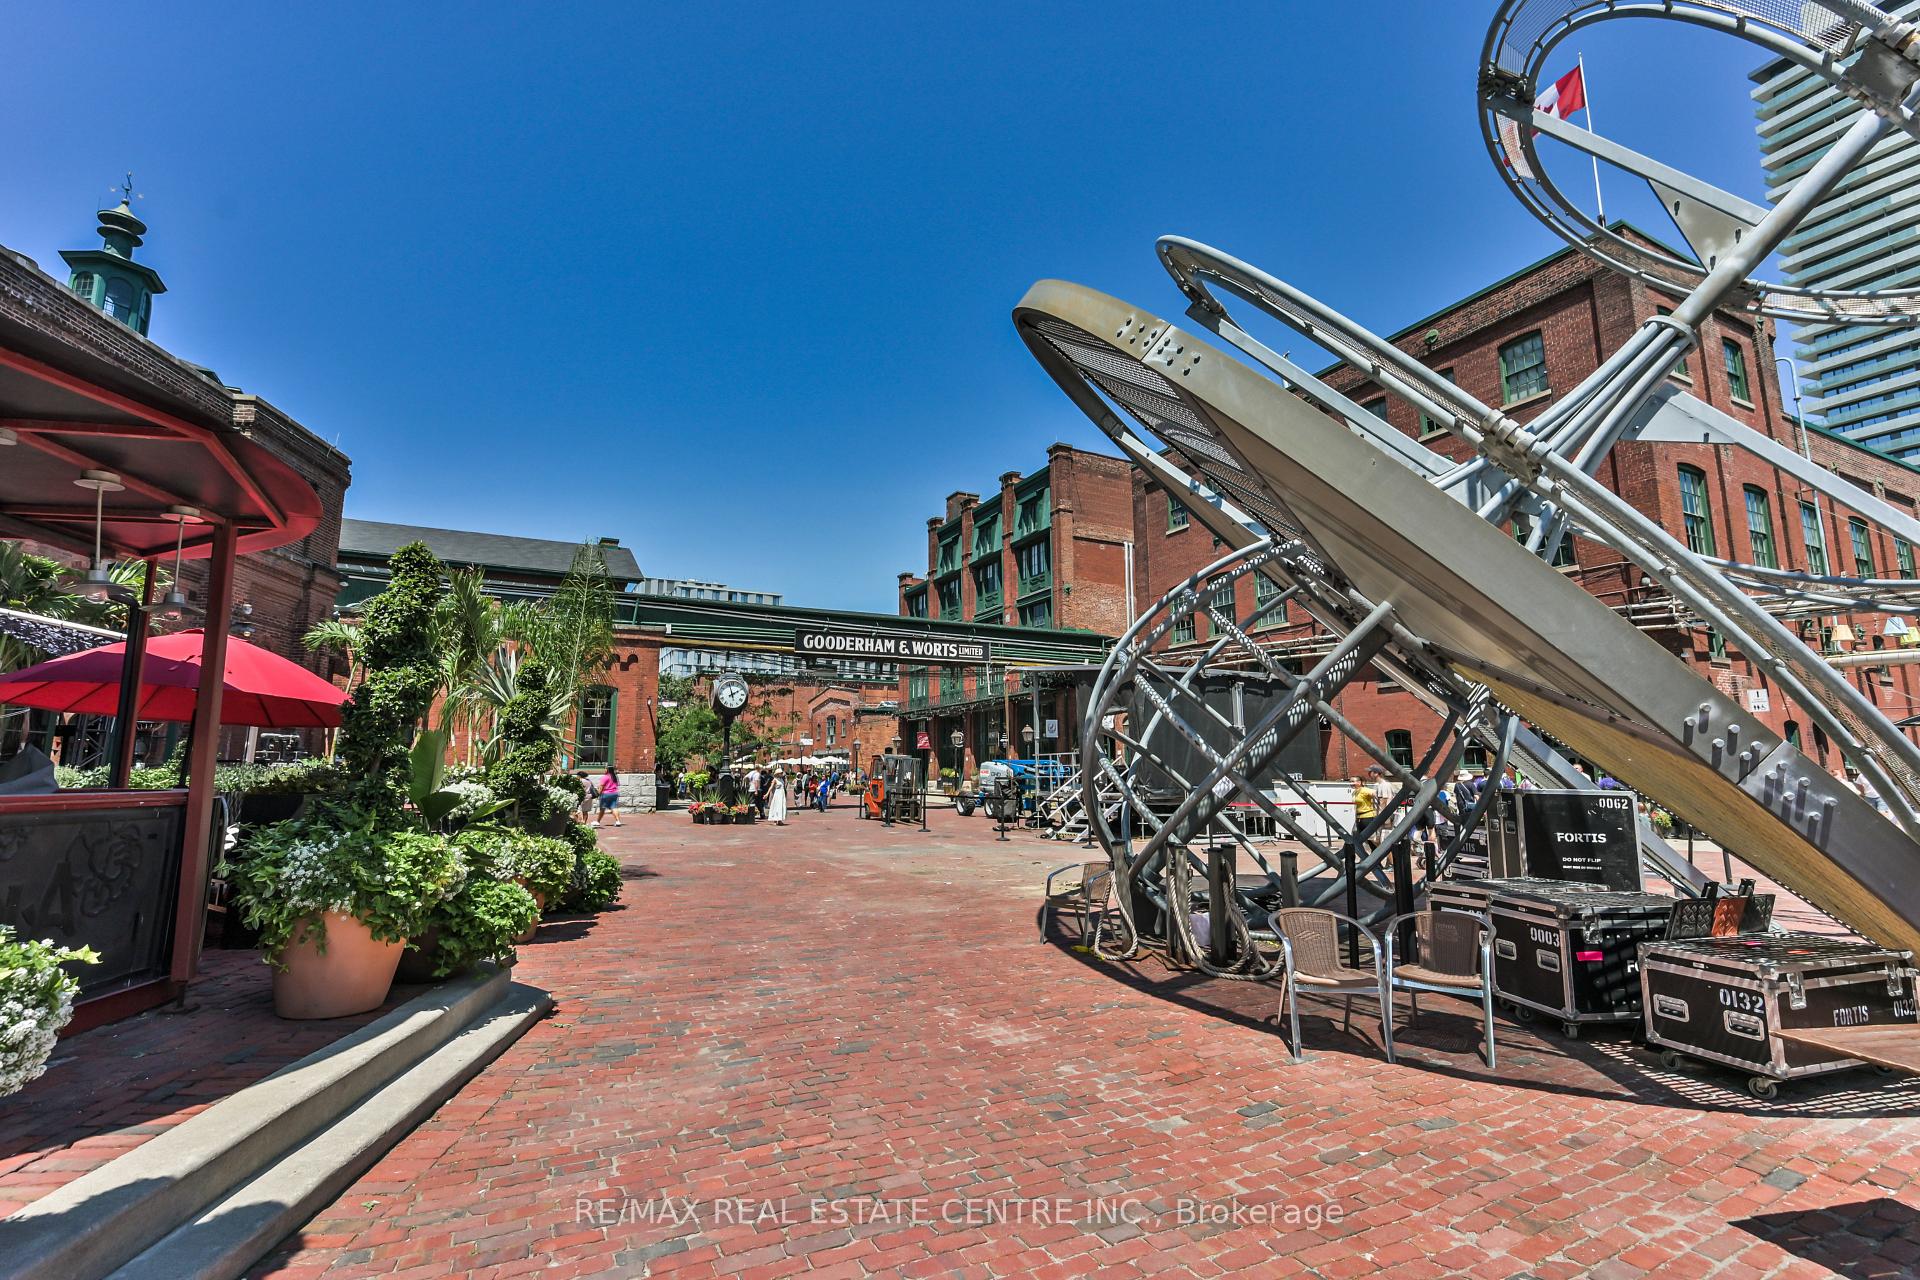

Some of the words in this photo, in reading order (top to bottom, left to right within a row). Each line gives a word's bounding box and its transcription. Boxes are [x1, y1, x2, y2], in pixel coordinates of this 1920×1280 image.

[803, 634, 895, 654] GOODERHAM
[899, 640, 910, 655] &
[911, 642, 958, 657] WORTS
[958, 646, 983, 656] LIMITED
[1599, 798, 1629, 809] 0062
[1556, 832, 1607, 843] FORTIS
[1530, 927, 1560, 947] 0003
[1719, 988, 1765, 1013] 0132
[1833, 1005, 1869, 1027] FORTIS
[1893, 999, 1916, 1018] 0132
